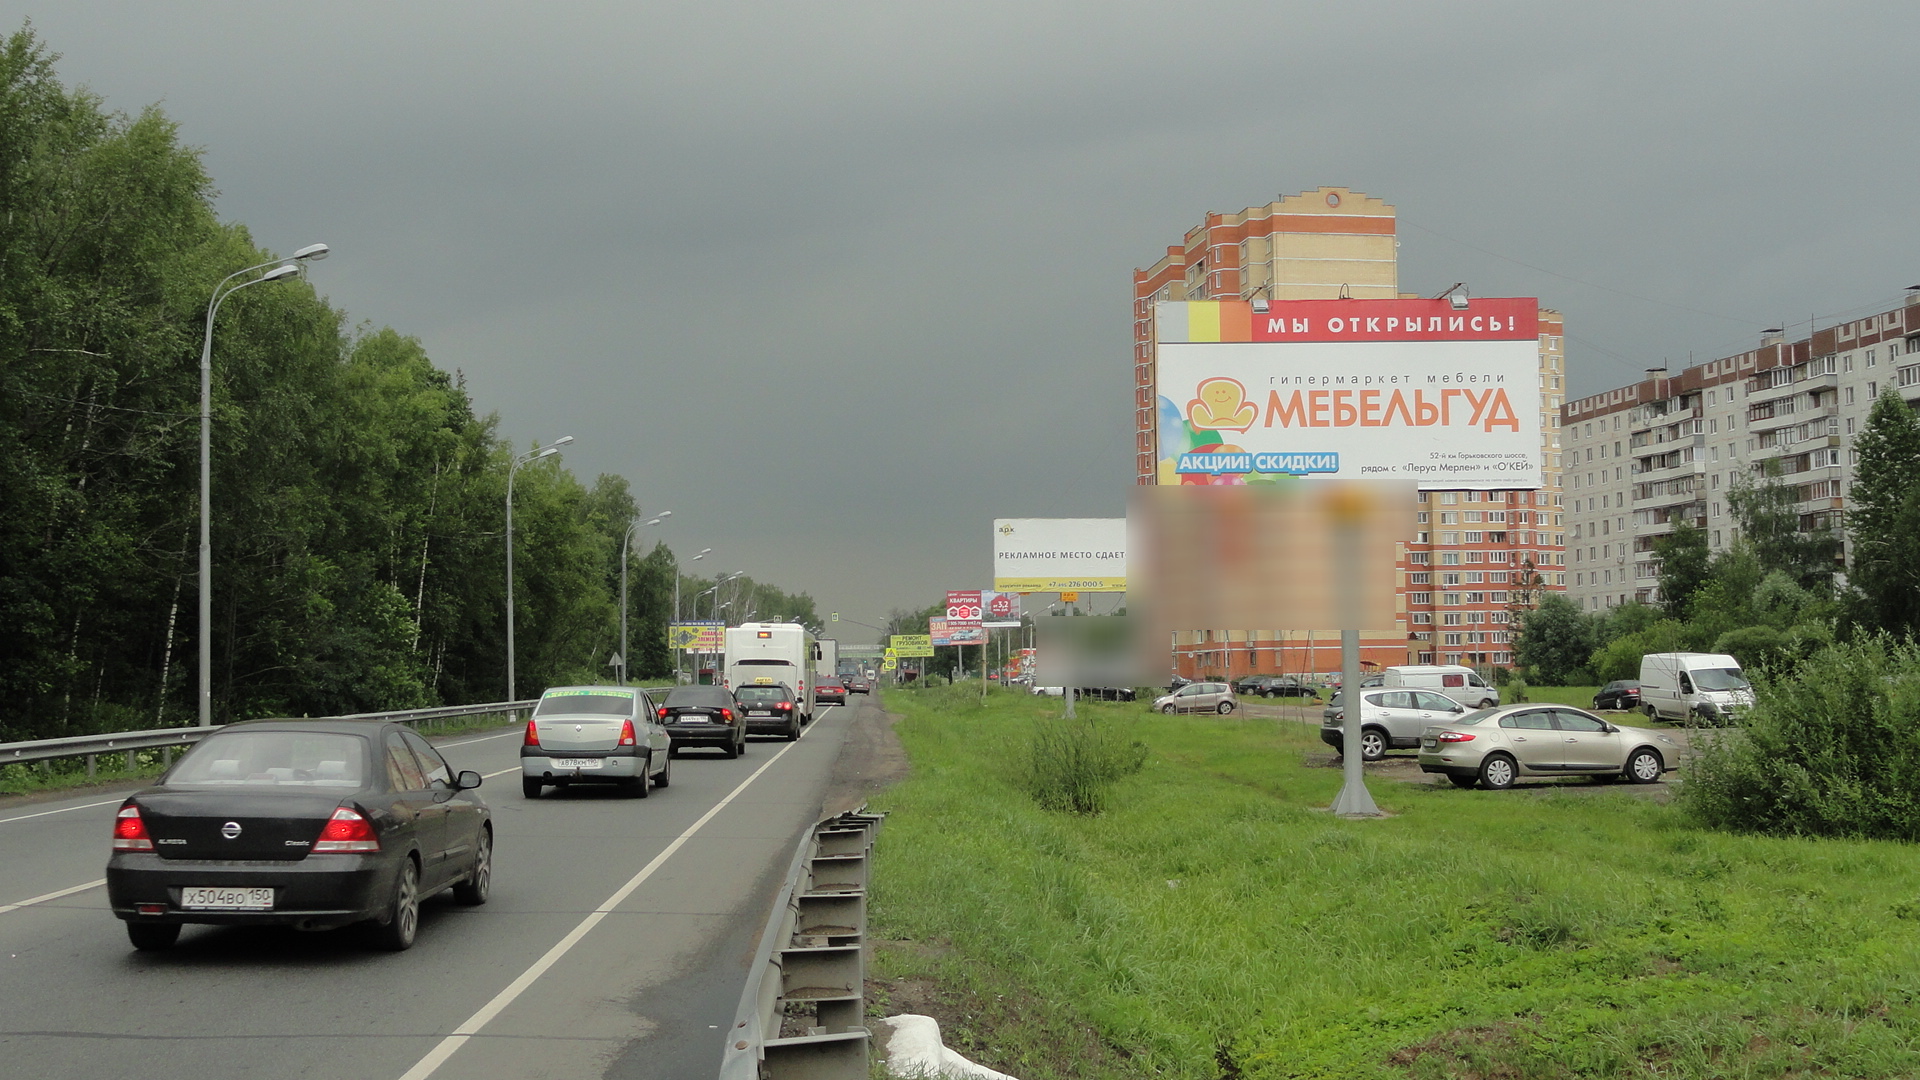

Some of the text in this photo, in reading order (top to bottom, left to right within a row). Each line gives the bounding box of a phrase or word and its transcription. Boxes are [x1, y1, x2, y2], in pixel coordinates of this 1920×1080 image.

[1267, 316, 1515, 333] МЫ ОТКРЫЛИСЬ!
[1269, 372, 1505, 386] гипермаркет мебели
[1264, 388, 1519, 433] МЕБЕЛЬГУД
[1179, 455, 1250, 471] АКЦИИ!
[1256, 455, 1336, 471] СКИДКИ!
[1429, 452, 1446, 460] 52-й
[1458, 452, 1503, 461] Горьковского
[1361, 465, 1389, 474] рядом
[1402, 463, 1437, 474] «Леруа
[1439, 463, 1481, 474] Мерлен»
[999, 551, 1126, 560] РЕКЛАМНОЕ МЕСТО СДАЕТ
[187, 889, 270, 904] Х504ВО 150
